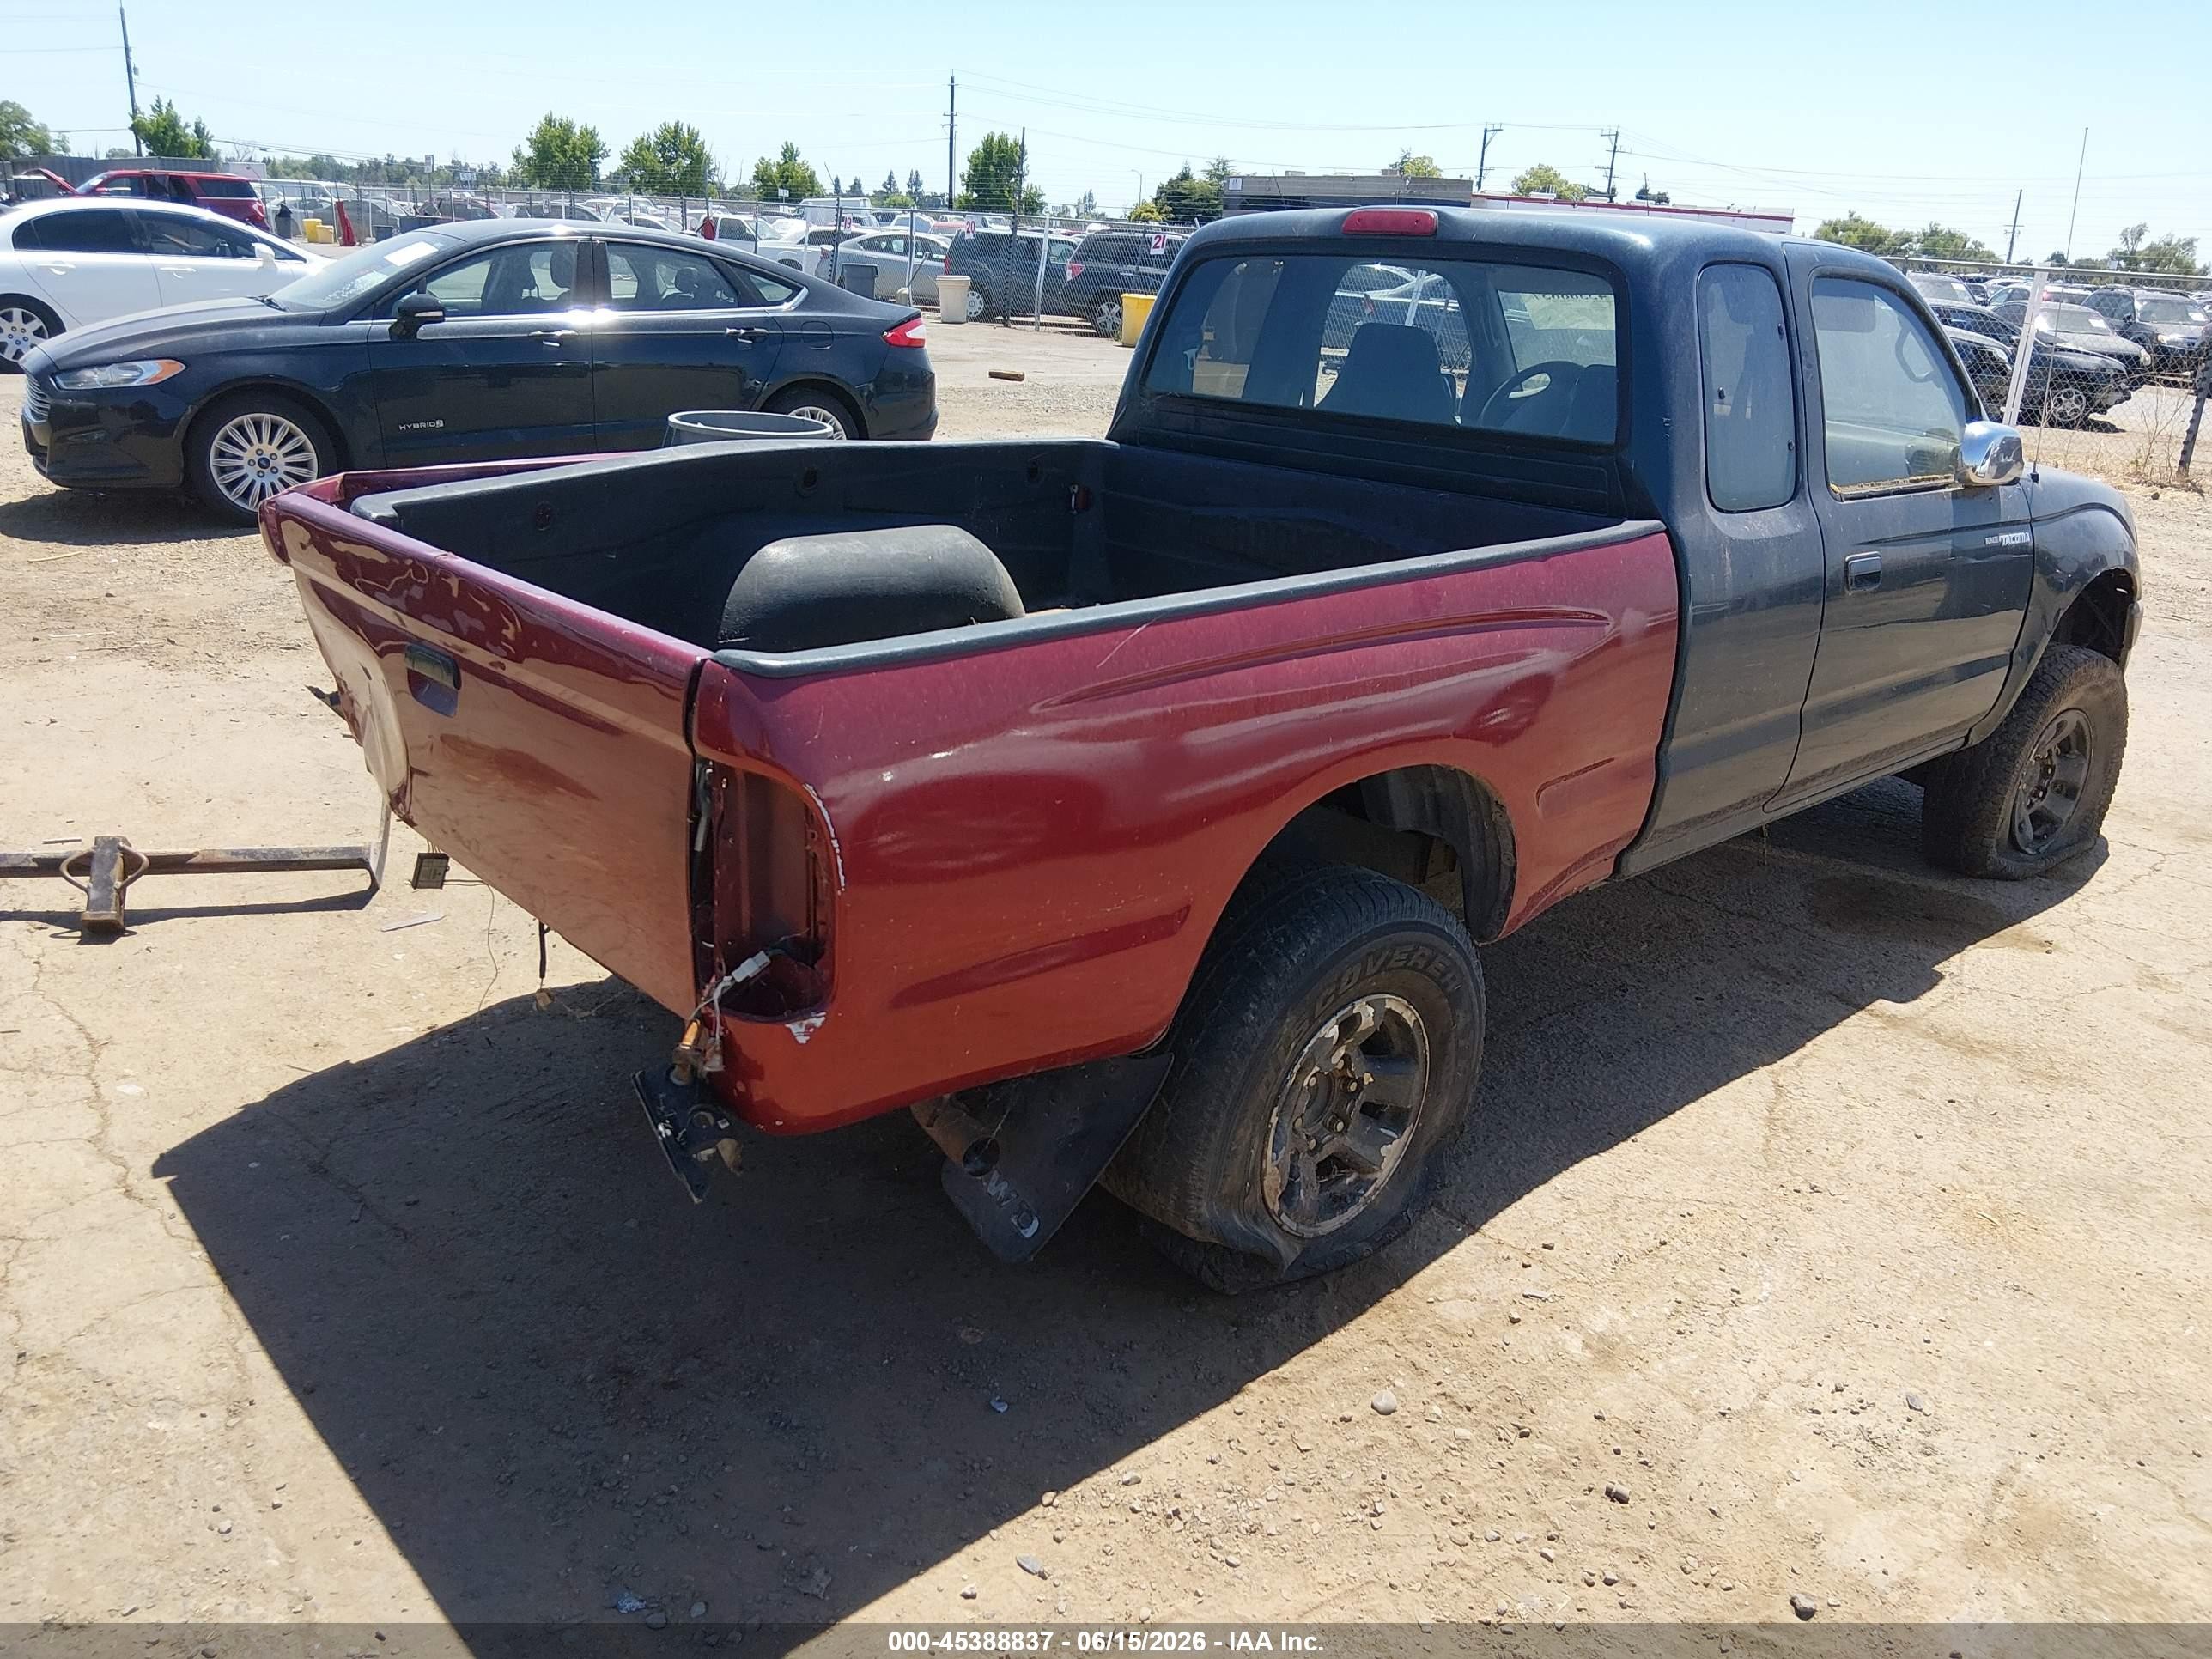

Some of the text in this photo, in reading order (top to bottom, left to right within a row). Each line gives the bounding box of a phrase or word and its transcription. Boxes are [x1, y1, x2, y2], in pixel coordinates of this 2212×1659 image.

[844, 216, 852, 230] 19
[966, 220, 975, 234] 20
[1152, 234, 1166, 249] 21
[398, 421, 436, 430] HYBRID
